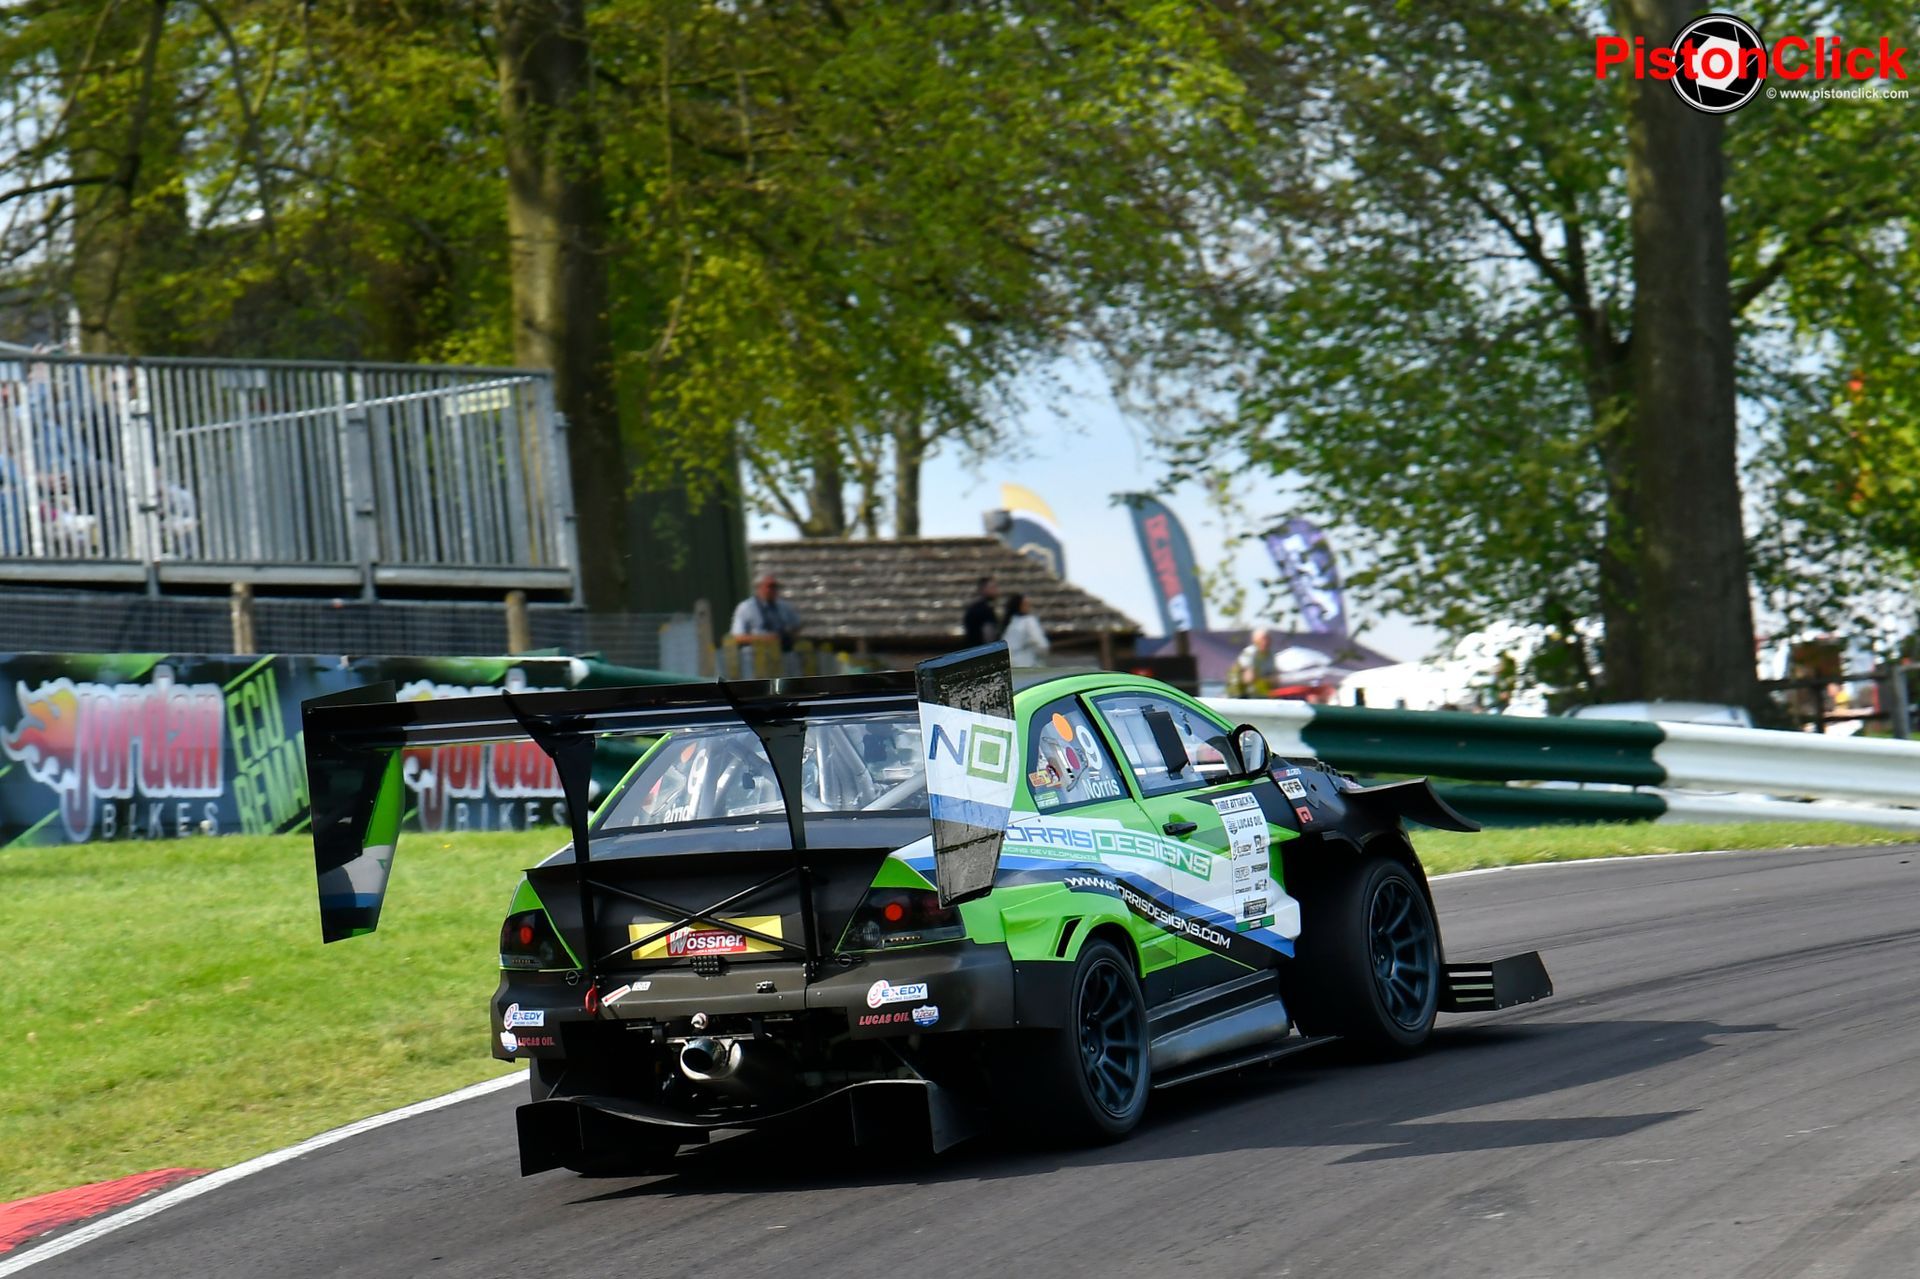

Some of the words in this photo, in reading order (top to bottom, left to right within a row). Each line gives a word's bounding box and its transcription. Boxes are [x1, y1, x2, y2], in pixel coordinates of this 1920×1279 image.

[226, 667, 286, 773] ECU
[1075, 725, 1103, 770] 9
[232, 730, 310, 835] REMA
[1081, 775, 1121, 800] Norris
[102, 801, 220, 839] BIKES
[1237, 817, 1254, 829] LUCAS
[1004, 825, 1095, 849] ORRIS
[1095, 831, 1210, 877] DESIGNS
[670, 927, 743, 954] Wössner
[881, 984, 925, 998] EXEDY
[512, 1011, 542, 1021] EXEDY
[859, 1013, 892, 1026] LUCAS
[893, 1011, 910, 1023] OIL
[517, 1036, 541, 1047] LUCAS
[541, 1036, 556, 1046] OIL
